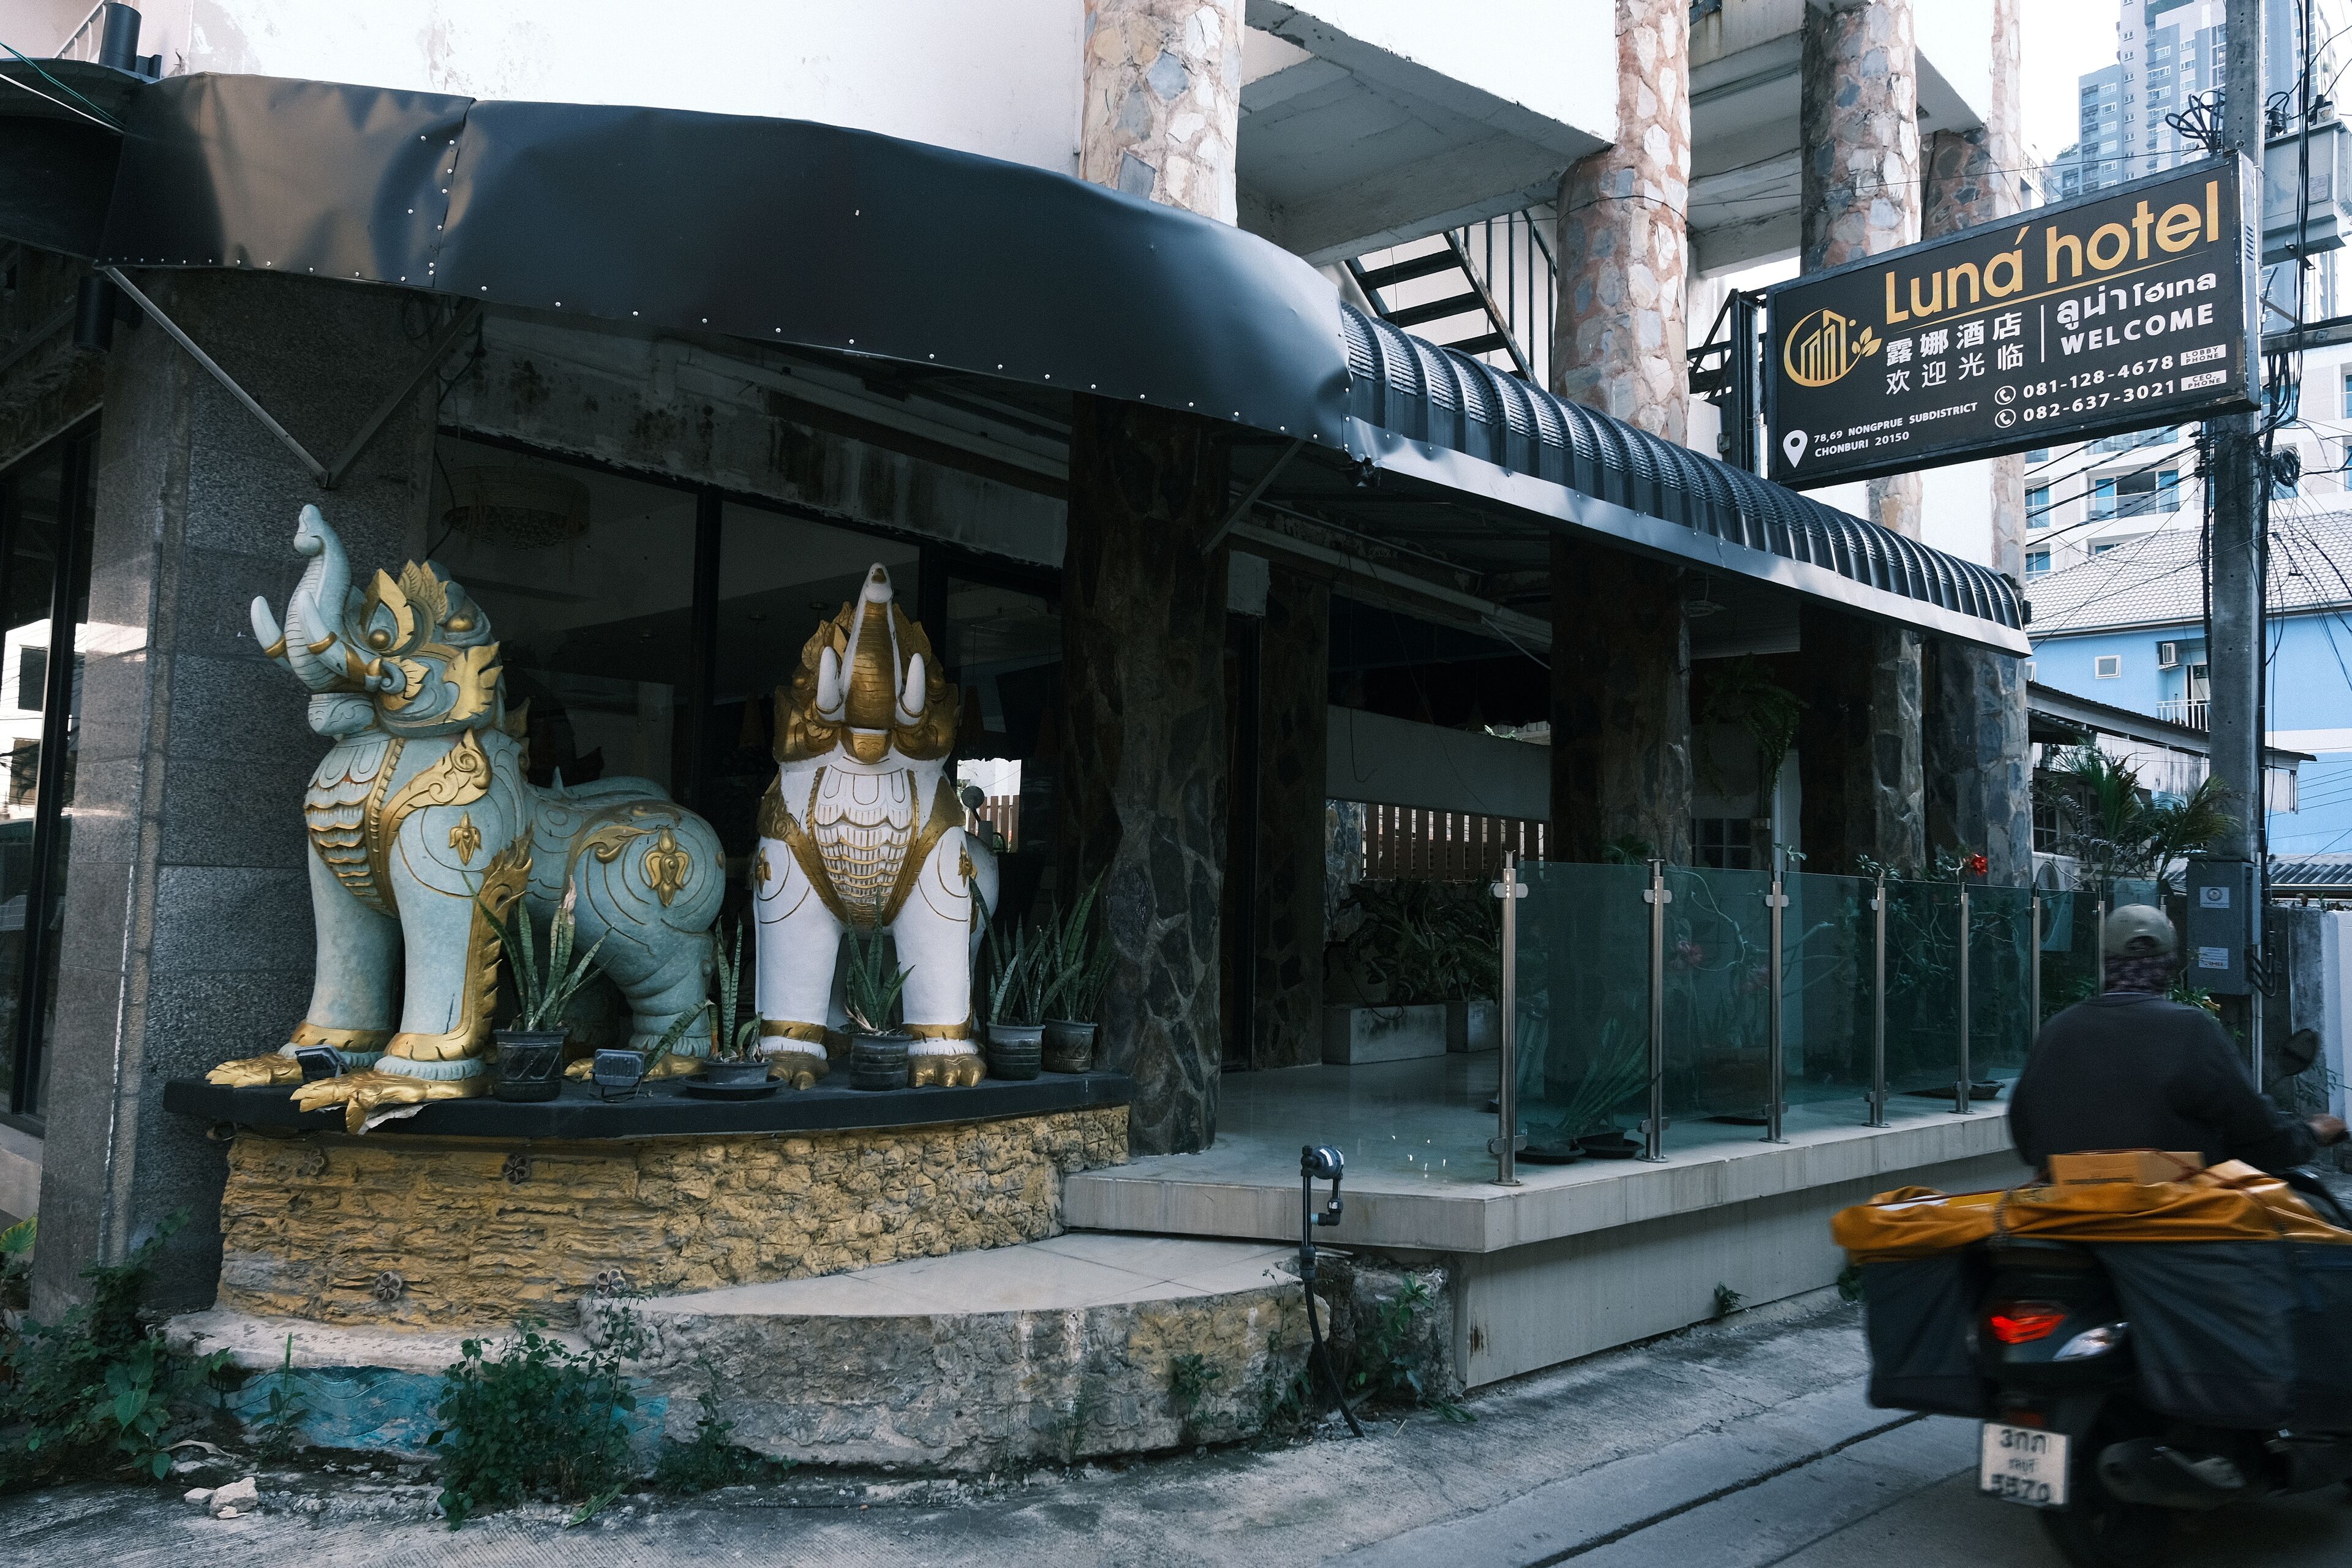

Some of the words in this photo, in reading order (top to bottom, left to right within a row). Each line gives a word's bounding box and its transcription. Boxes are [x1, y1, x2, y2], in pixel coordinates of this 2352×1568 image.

[1886, 226, 2030, 325] Luná
[2046, 181, 2218, 284] hotel
[1887, 312, 2022, 367] 露娜酒店
[2060, 303, 2214, 355] WELCOME
[1886, 343, 2024, 395] 欢迎光临
[2186, 347, 2219, 358] LOBBY
[2186, 353, 2219, 364] PHONE
[2023, 355, 2174, 398] 081-128-4678
[2188, 378, 2221, 388] PHONE
[2023, 380, 2174, 422] 082-637-3021
[1814, 431, 1842, 443] 78,69
[1849, 418, 1903, 437] NONGPRUE
[1909, 402, 1978, 424] SUBDISTRICT
[1815, 439, 1868, 458] CHONBURI
[1875, 431, 1910, 447] 20150
